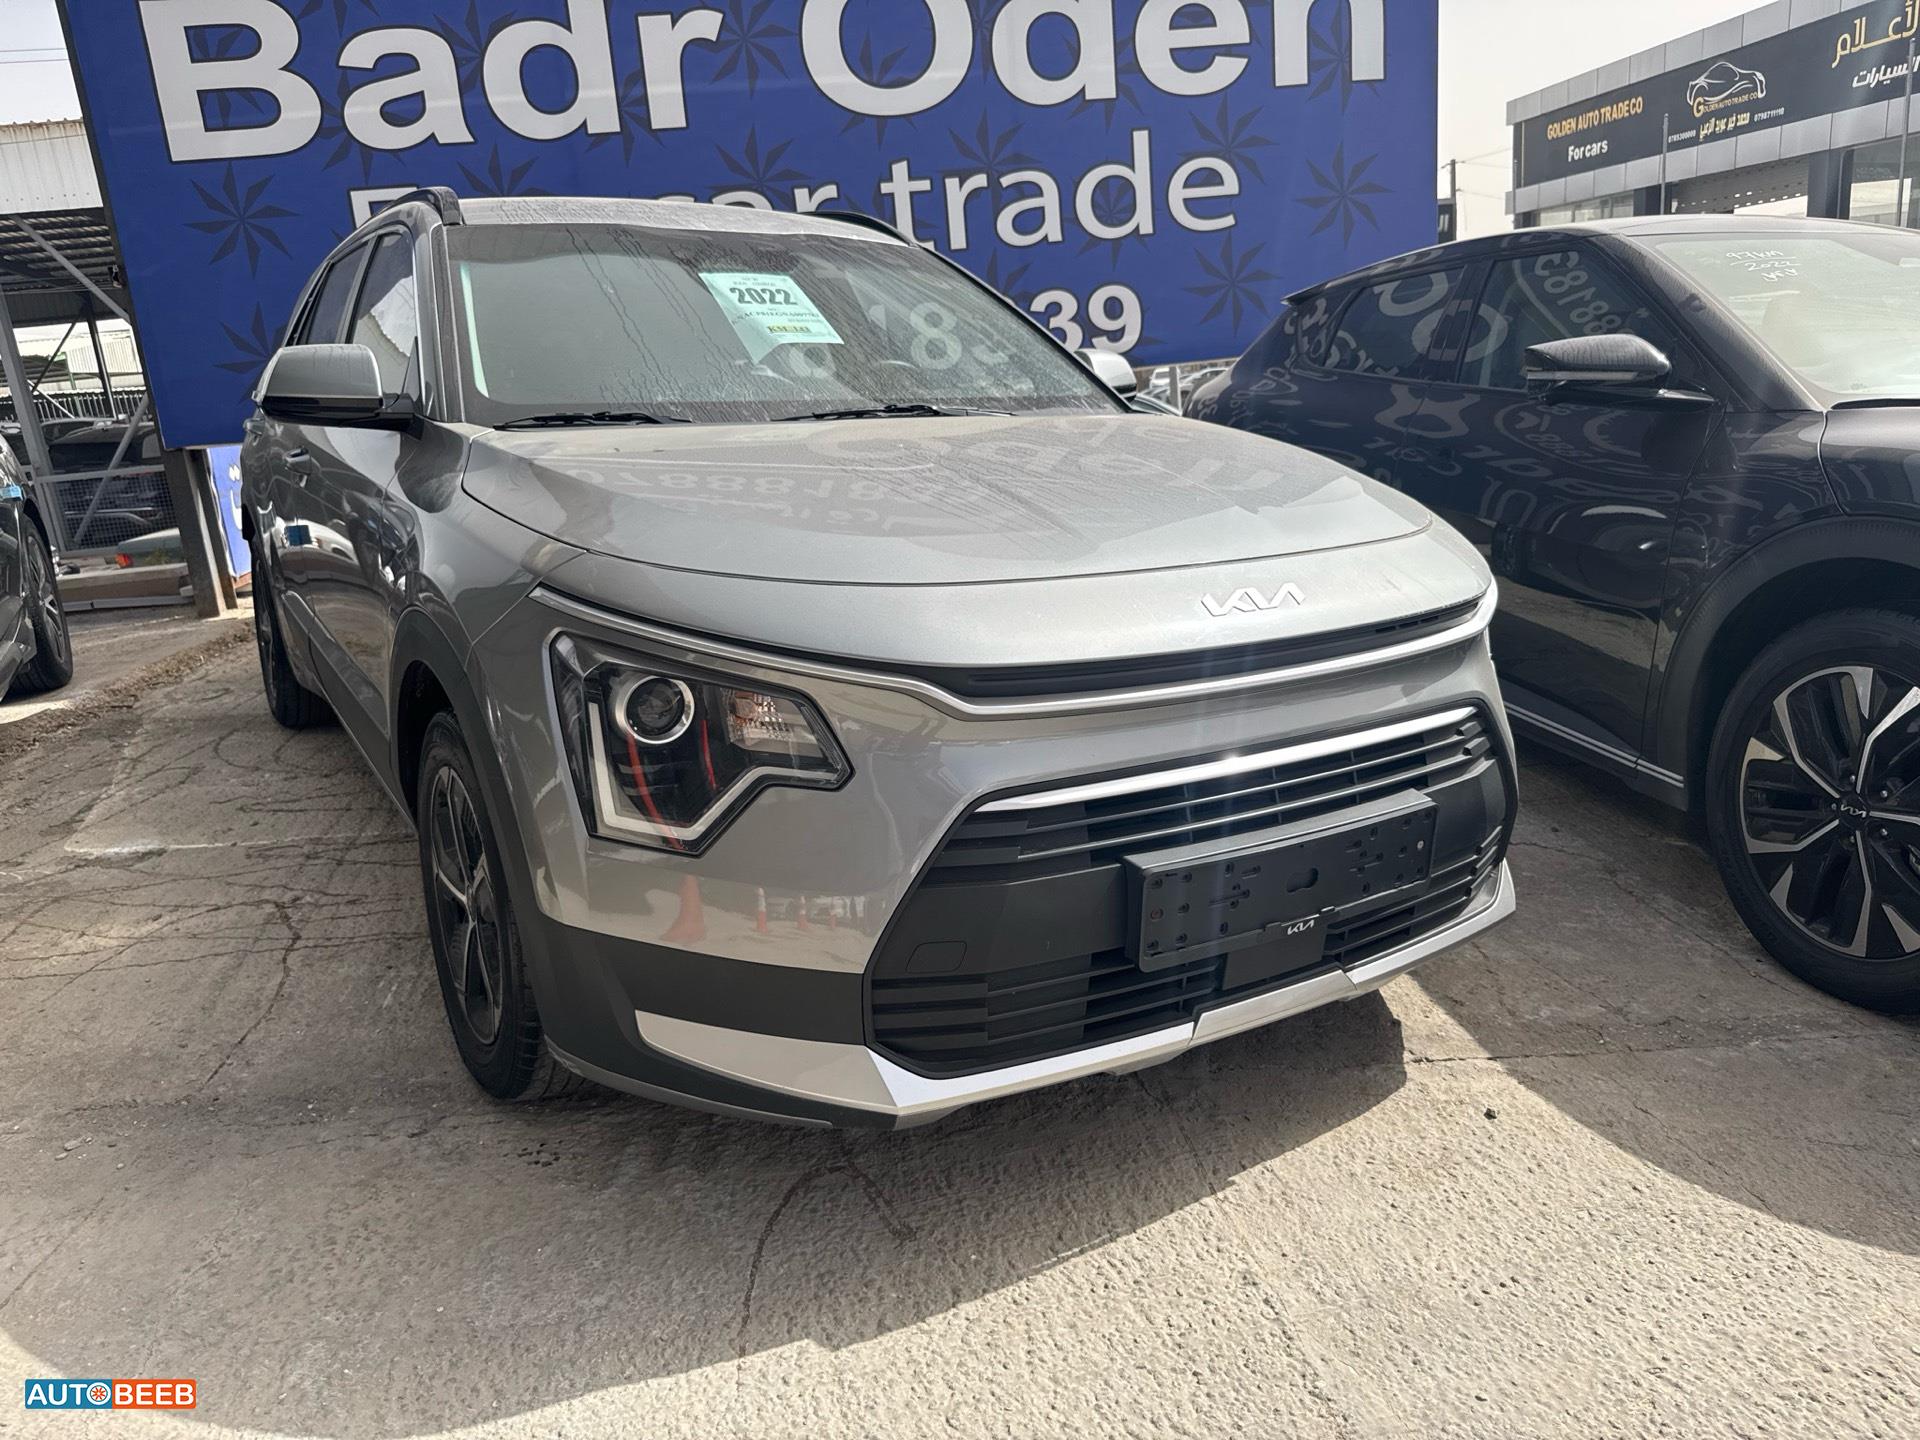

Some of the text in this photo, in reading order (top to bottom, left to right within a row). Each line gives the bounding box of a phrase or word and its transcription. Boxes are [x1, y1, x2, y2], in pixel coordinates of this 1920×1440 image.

[143, 0, 1387, 162] Badr Oden
[1547, 96, 1643, 140] GOLDEN AUTO TRADE CO
[1568, 140, 1608, 162] For cars
[880, 129, 1240, 251] trade
[729, 287, 798, 305] 2022
[1029, 284, 1142, 354] 39
